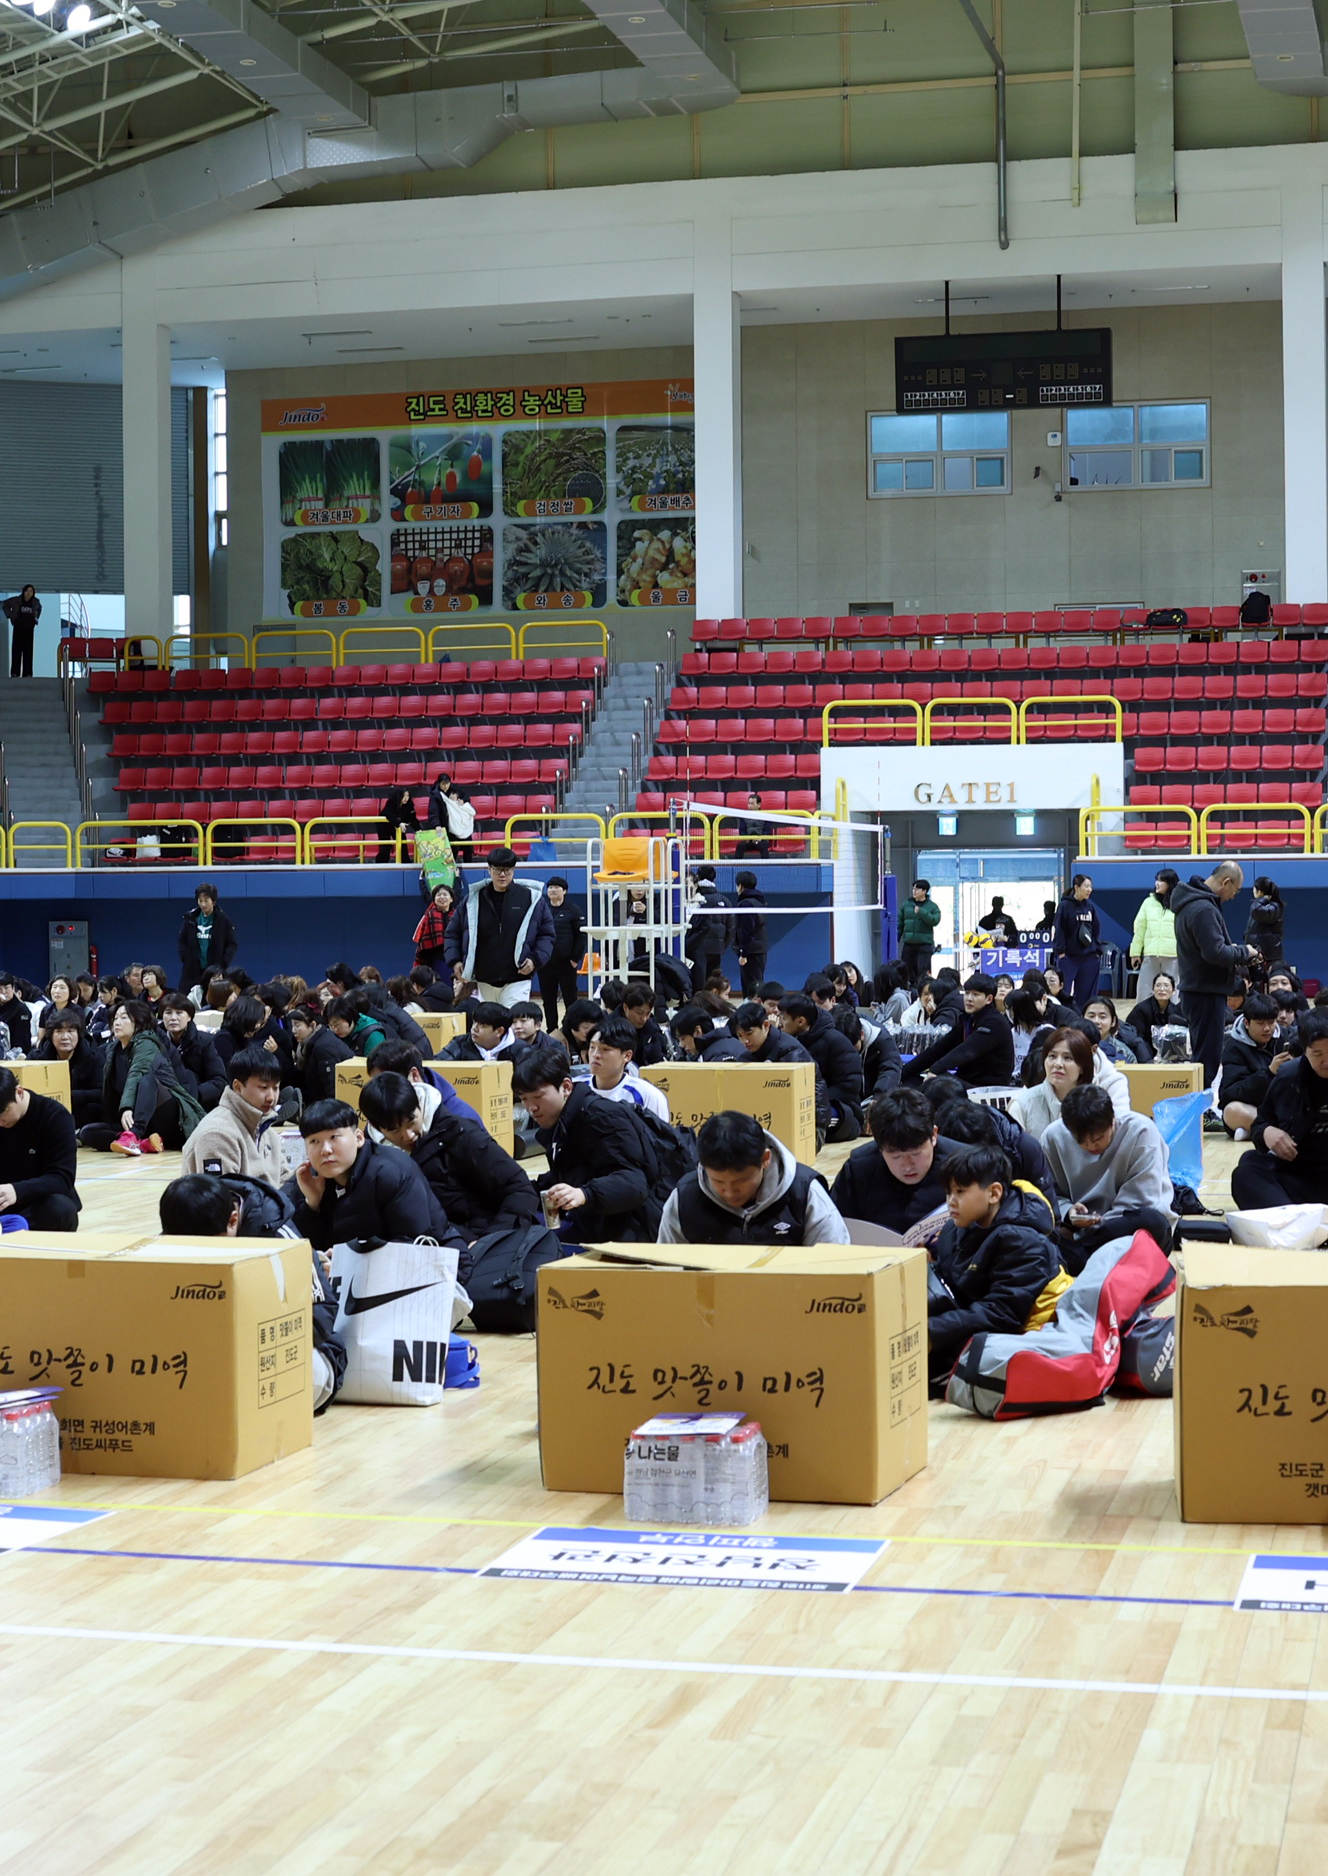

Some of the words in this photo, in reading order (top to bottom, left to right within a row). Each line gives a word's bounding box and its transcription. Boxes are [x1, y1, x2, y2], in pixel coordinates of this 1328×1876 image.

[406, 396, 447, 420] 진도
[453, 391, 515, 418] 친환경
[521, 387, 586, 415] 농산물
[279, 406, 323, 425] Jindo
[536, 500, 574, 514] 검정쌀
[646, 495, 693, 509] 겨울배추
[309, 509, 353, 523] 겨울대파
[423, 505, 461, 518] 구기자
[422, 597, 461, 612] 홍주
[535, 593, 574, 608] 와송
[650, 590, 689, 604] 울금
[913, 781, 1017, 804] GATE1
[986, 950, 1041, 968] 기록석
[763, 1080, 786, 1088] Jindo
[1160, 1080, 1184, 1090] Jindo
[171, 1282, 219, 1301] Jindo
[805, 1295, 856, 1315] Jindo
[284, 1347, 299, 1364] 진도군
[131, 1351, 189, 1390] 미역
[587, 1363, 637, 1395] 진도
[762, 1367, 825, 1408] 미역
[1236, 1384, 1293, 1417] 진도
[90, 1418, 156, 1437] 귀성어촌계
[69, 1435, 134, 1453] 진도씨푸드
[1278, 1461, 1325, 1480] 진도군
